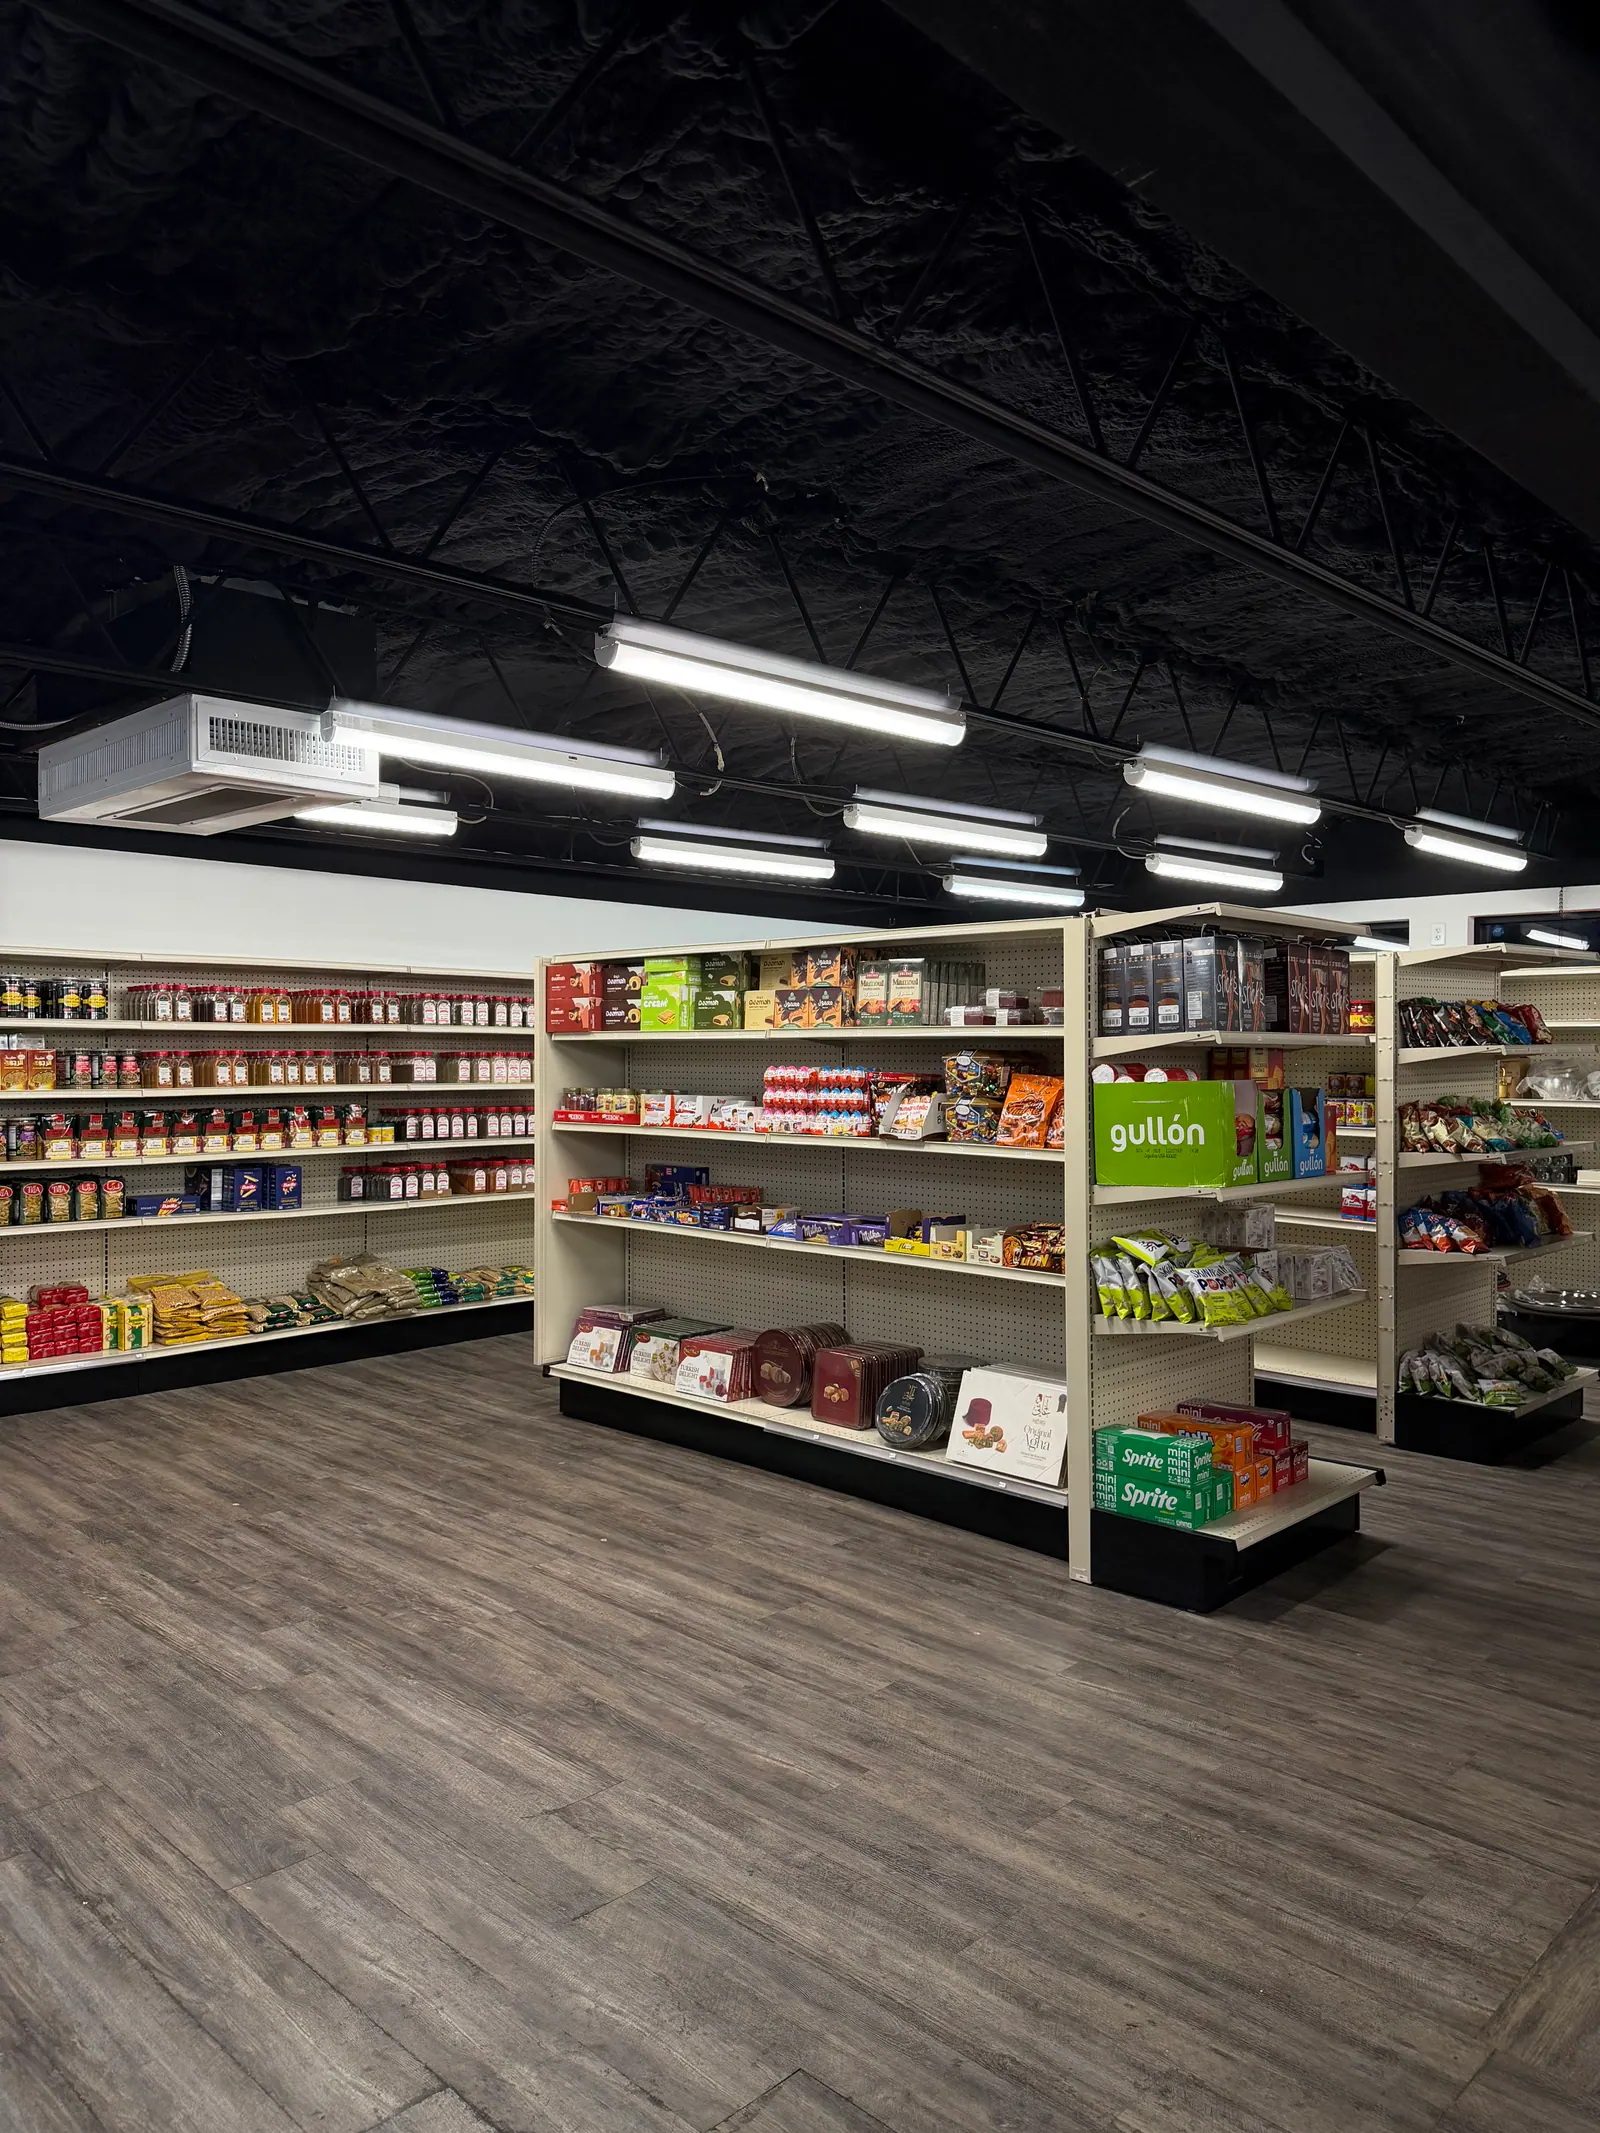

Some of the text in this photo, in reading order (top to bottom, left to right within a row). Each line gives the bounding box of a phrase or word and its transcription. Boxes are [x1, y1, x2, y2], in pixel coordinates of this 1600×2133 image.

[1110, 1114, 1205, 1152] gullón
[1264, 1155, 1288, 1177] gullón
[1300, 1154, 1323, 1175] gullón
[802, 1224, 823, 1237] Milka
[858, 1230, 881, 1242] Milka
[679, 1371, 698, 1379] DELIGHT
[680, 1364, 700, 1373] TURKISH
[1179, 1405, 1202, 1418] mini
[1024, 1425, 1052, 1438] Original
[1122, 1448, 1164, 1469] Sprite
[1168, 1448, 1191, 1459] mini
[1168, 1457, 1191, 1469] mini
[1193, 1452, 1212, 1470] Sprite
[1096, 1472, 1117, 1484] mini
[1168, 1467, 1191, 1478] mini
[1196, 1468, 1210, 1481] mini
[1096, 1482, 1117, 1493] mini
[1096, 1491, 1117, 1503] mini
[1121, 1483, 1178, 1511] Sprite
